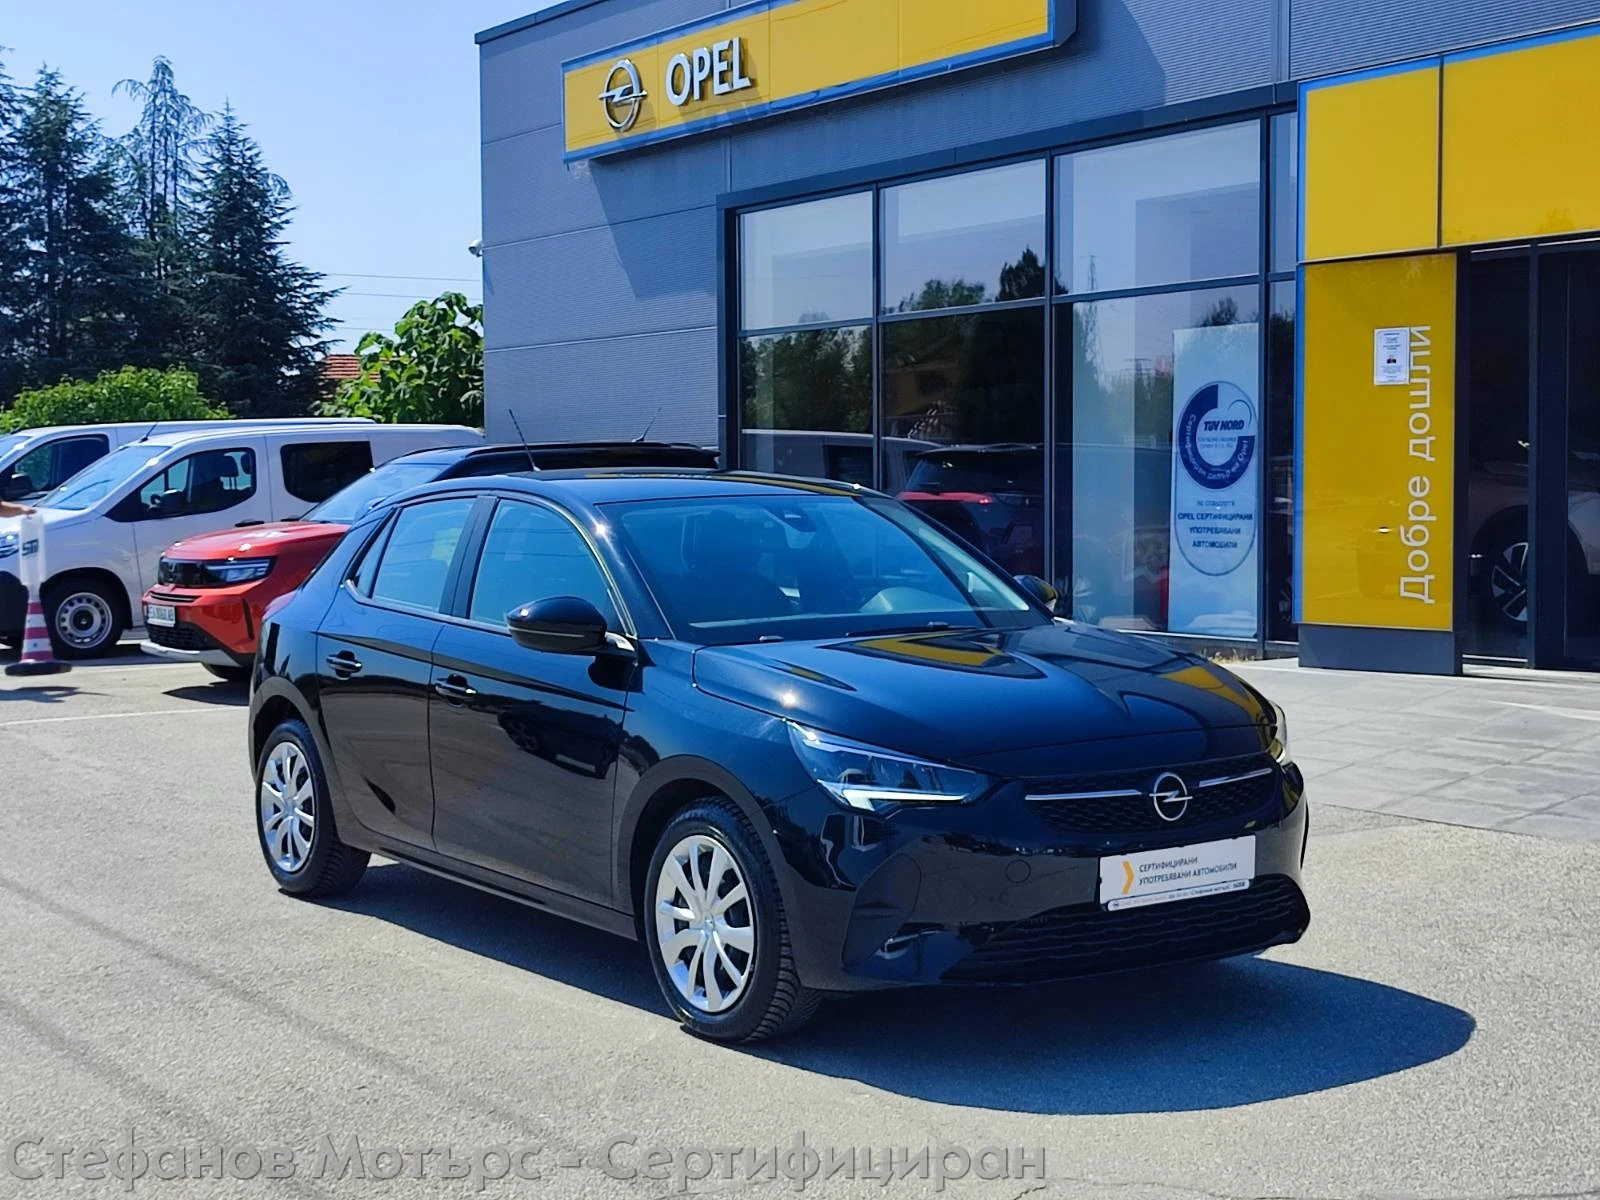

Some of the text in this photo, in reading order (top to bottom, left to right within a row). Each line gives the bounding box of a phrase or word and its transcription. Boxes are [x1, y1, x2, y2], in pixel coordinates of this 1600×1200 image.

[665, 36, 752, 106] OPEL
[1219, 419, 1245, 430] NORD
[1399, 325, 1436, 605] Добре дошли
[1138, 856, 1199, 873] СЕРТИФИЦИРАНИ
[1138, 862, 1238, 886] УПОТРЕБЯВАНИ АВТОМОБИЛИ
